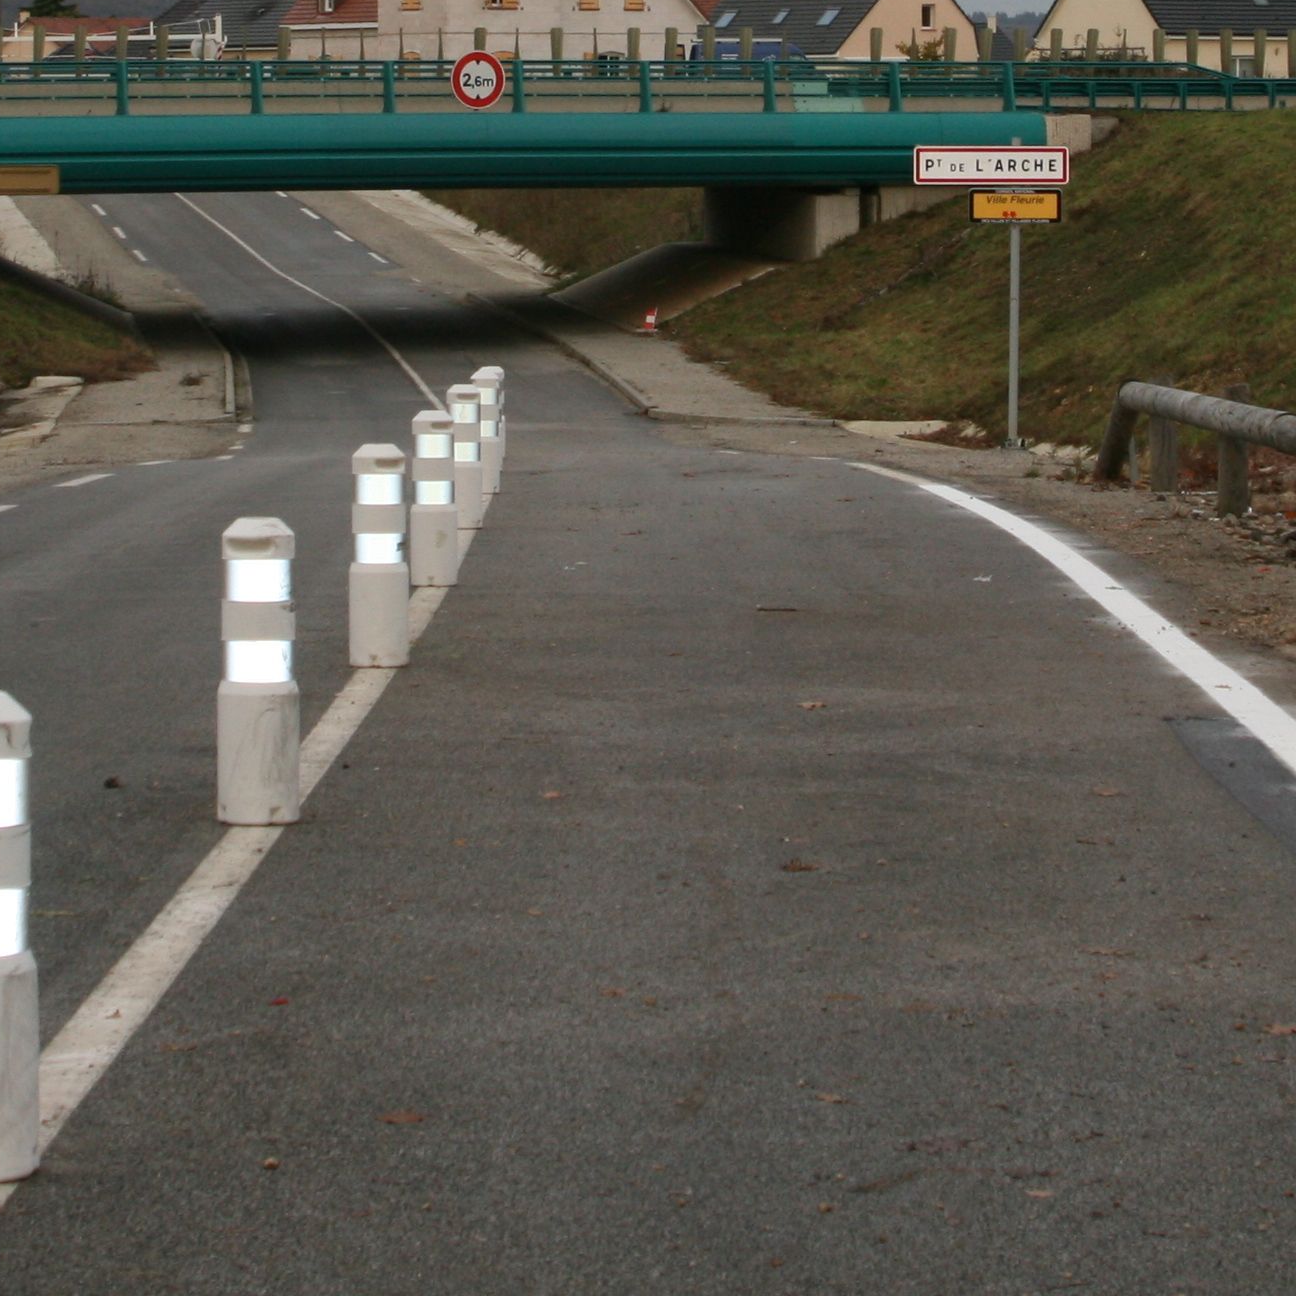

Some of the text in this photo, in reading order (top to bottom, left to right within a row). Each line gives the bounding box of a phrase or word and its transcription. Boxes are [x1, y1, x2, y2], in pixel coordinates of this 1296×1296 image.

[463, 73, 494, 88] 2,6m
[950, 163, 965, 172] DE
[976, 159, 1057, 172] L'ARCHE
[986, 195, 1045, 204] Ville Fleurie
